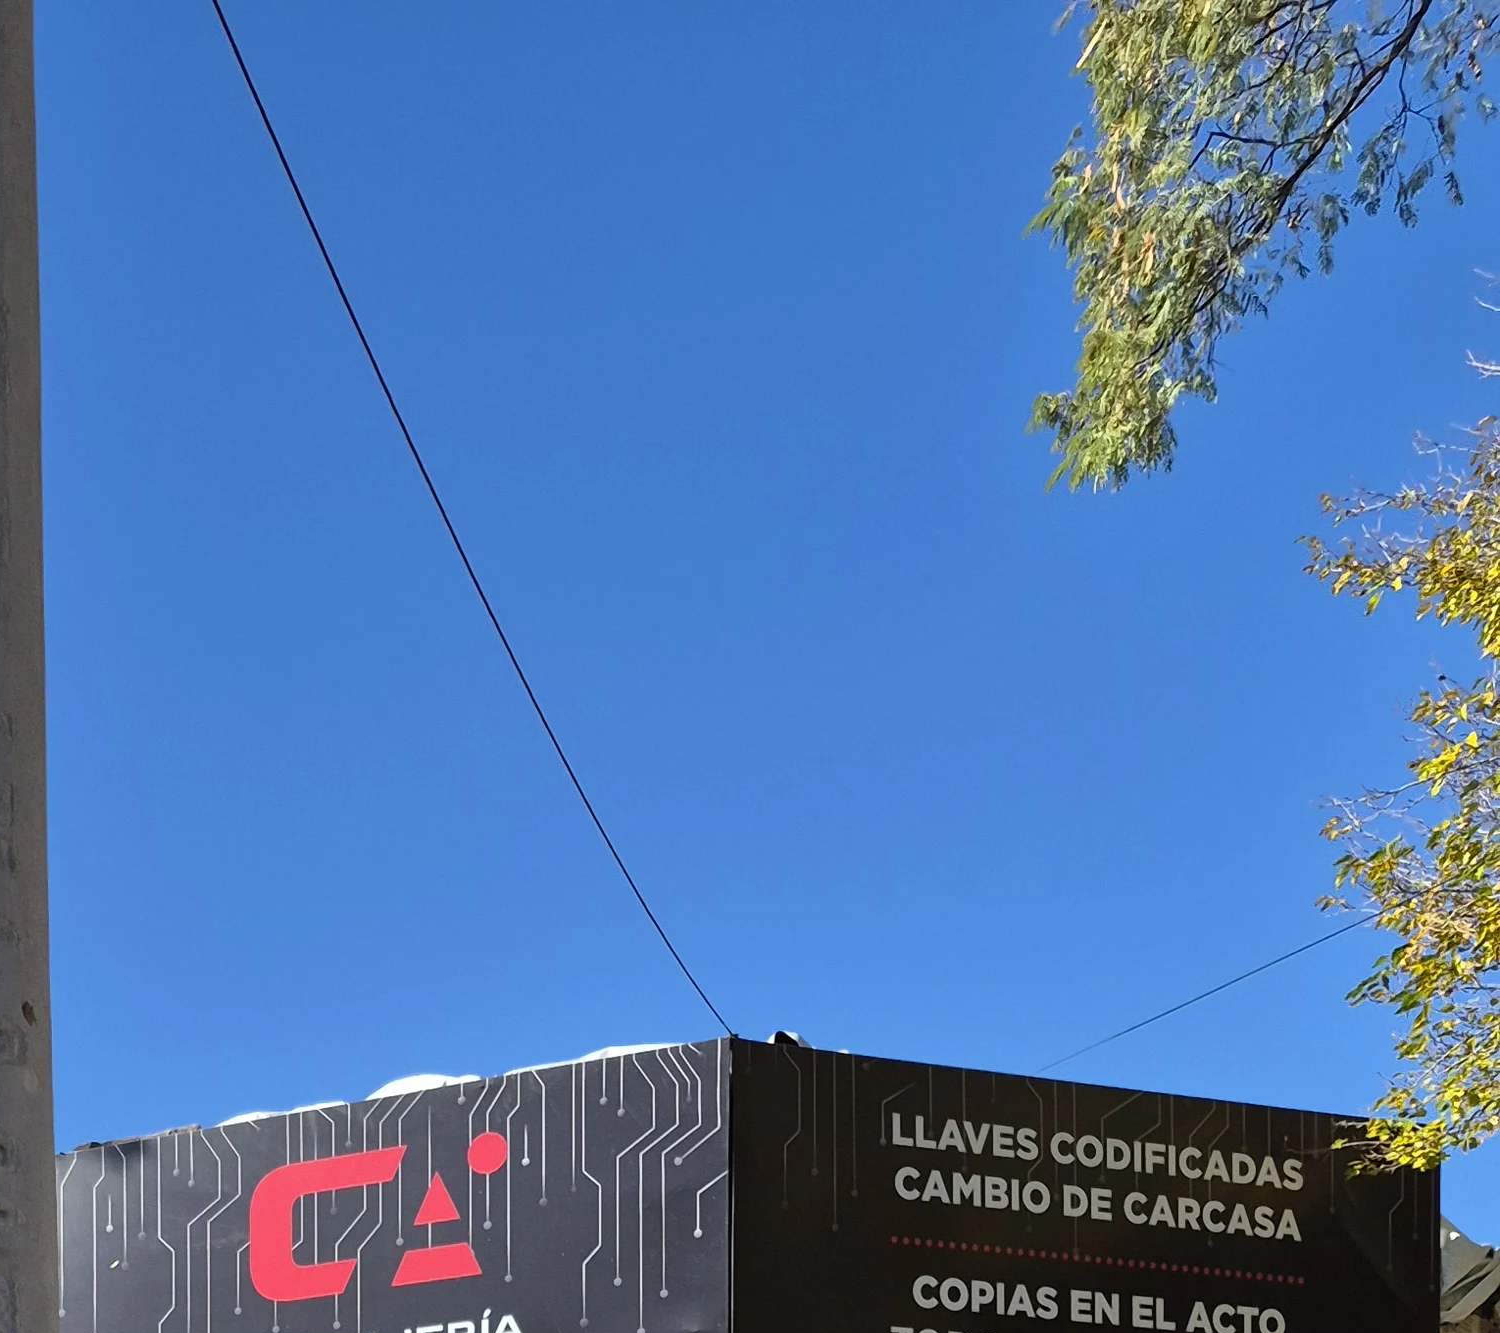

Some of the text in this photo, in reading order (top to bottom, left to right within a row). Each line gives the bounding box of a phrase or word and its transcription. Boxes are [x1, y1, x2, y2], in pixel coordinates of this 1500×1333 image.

[891, 1111, 1305, 1191] LLAVES CODIFICADAS
[894, 1166, 1303, 1242] CAMBIO DE CARCASA
[912, 1274, 1059, 1320] COPIAS
[1069, 1289, 1120, 1326] EN
[1131, 1296, 1177, 1331] EL
